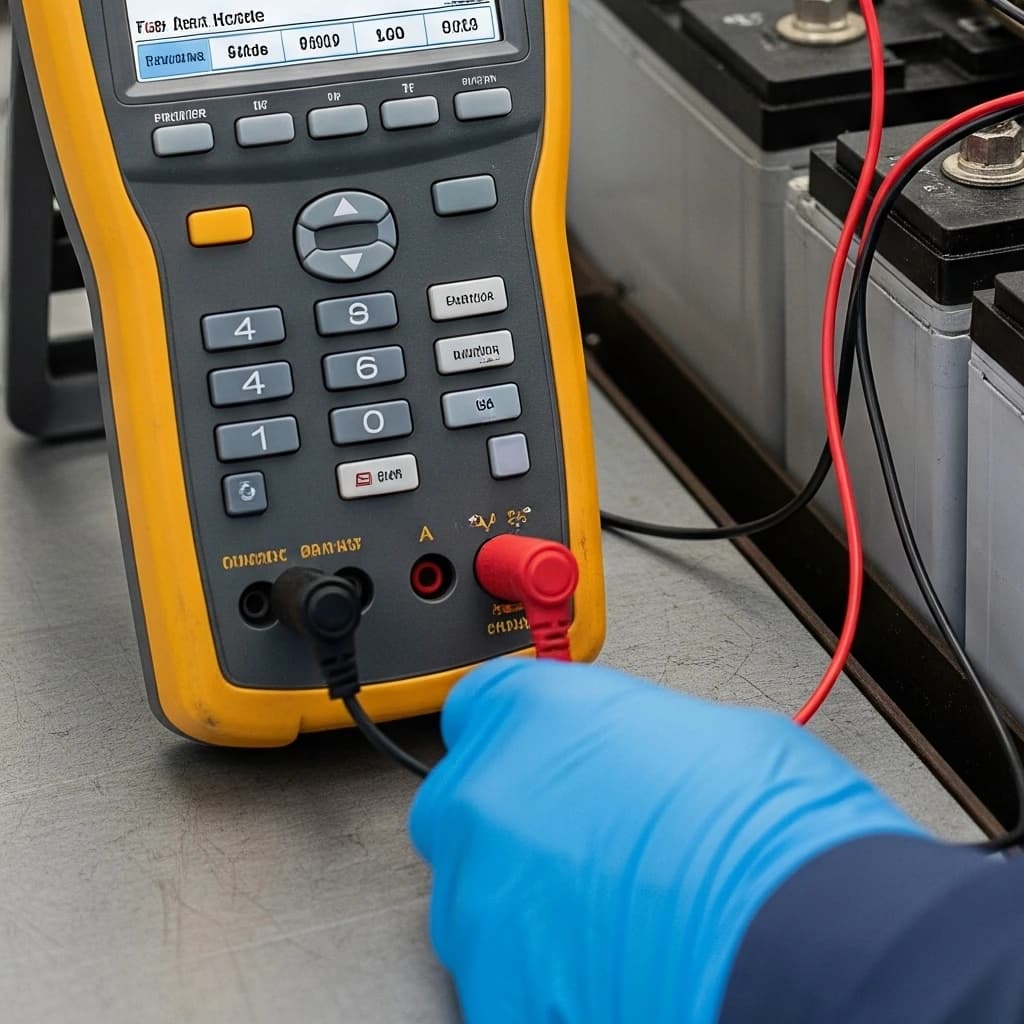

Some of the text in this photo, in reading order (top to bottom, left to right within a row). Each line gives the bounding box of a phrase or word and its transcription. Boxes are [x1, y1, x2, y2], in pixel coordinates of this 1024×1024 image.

[234, 316, 257, 341] 4
[356, 356, 378, 380] 6
[242, 370, 266, 395] 4
[251, 425, 268, 451] 1
[419, 525, 435, 543] A
